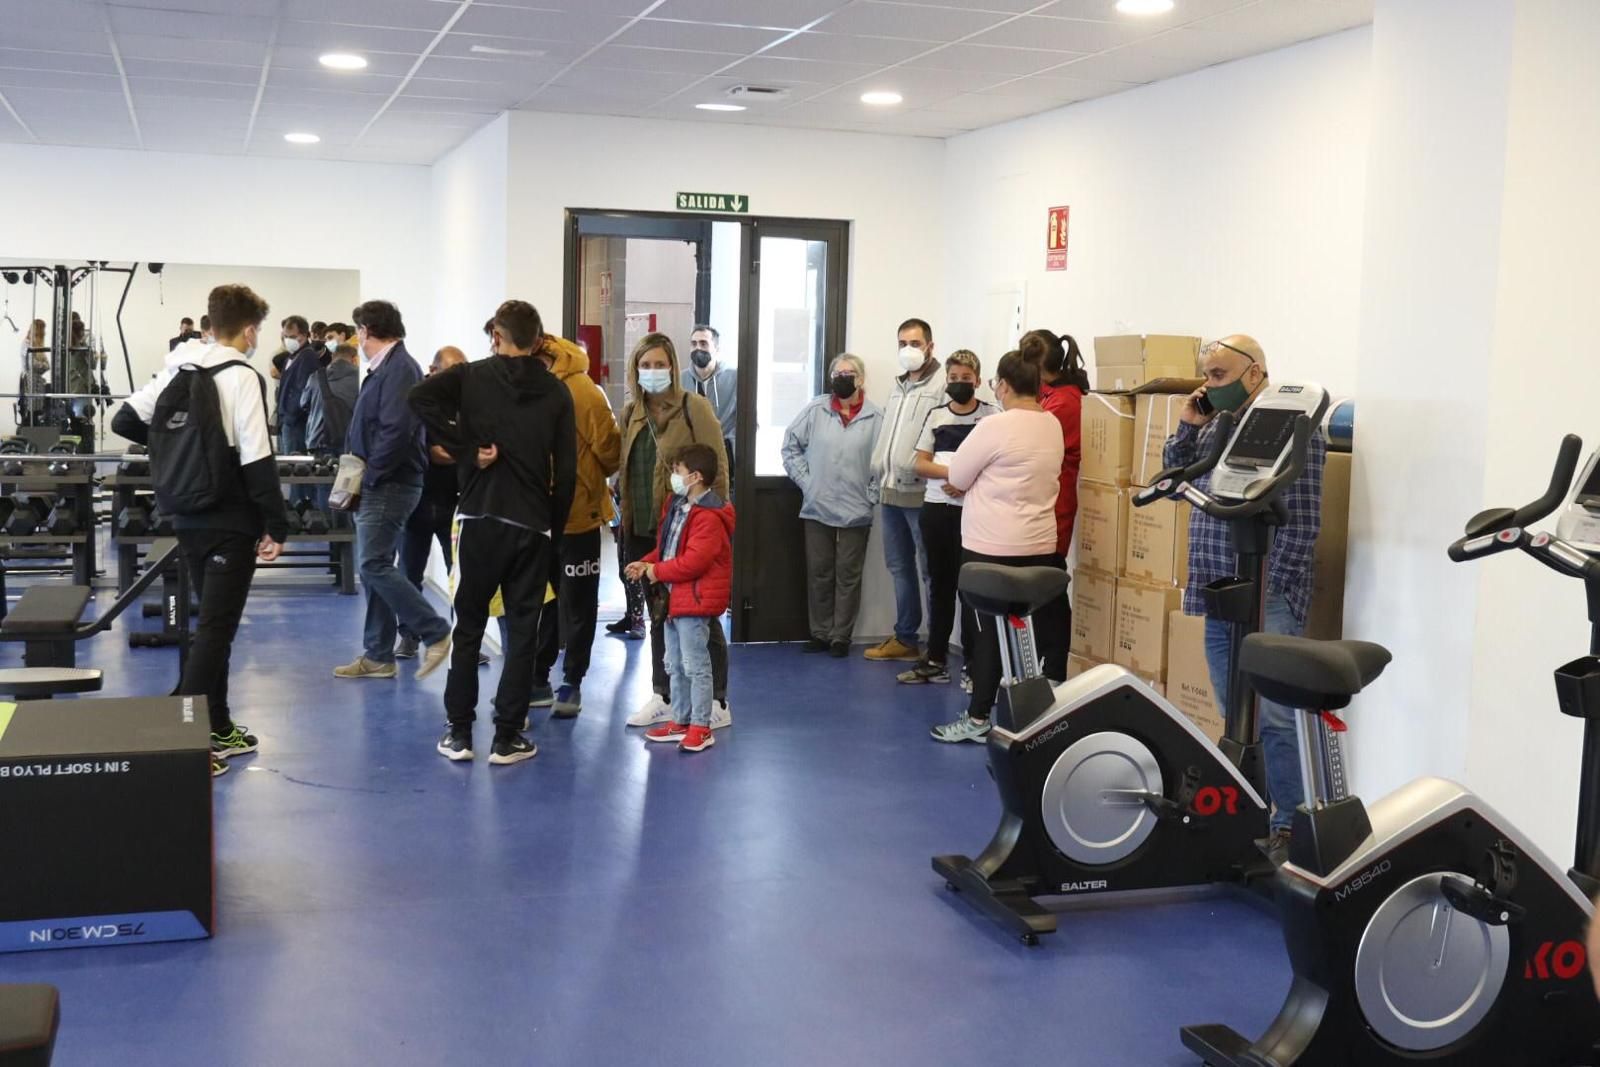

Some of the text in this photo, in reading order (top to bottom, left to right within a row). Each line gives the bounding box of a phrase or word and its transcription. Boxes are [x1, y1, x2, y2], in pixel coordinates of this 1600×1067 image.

[680, 194, 726, 210] SALIDA
[565, 558, 600, 577] adid
[13, 764, 52, 777] PLYO
[54, 762, 93, 776] SOFT
[95, 762, 103, 774] 1
[104, 761, 119, 773] IN
[121, 760, 131, 773] 3
[1189, 786, 1238, 816] OR
[1061, 880, 1107, 891] SALTER
